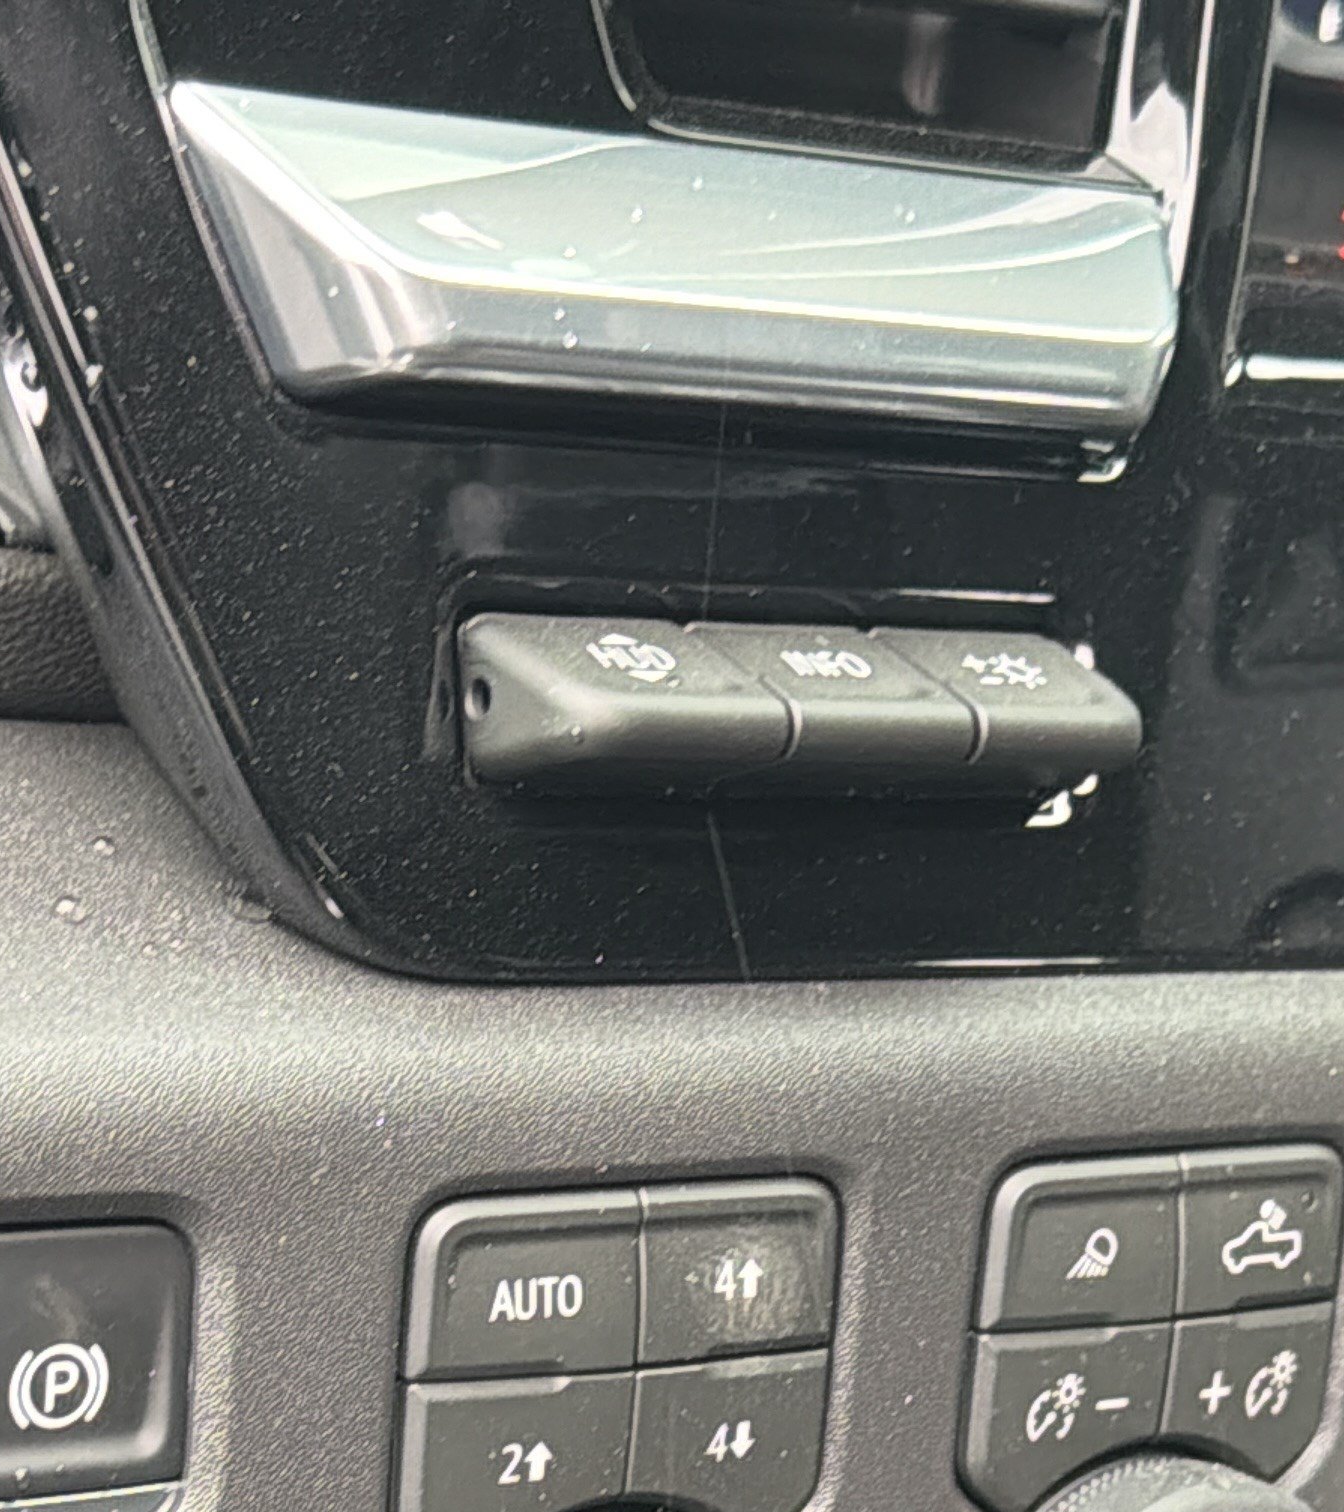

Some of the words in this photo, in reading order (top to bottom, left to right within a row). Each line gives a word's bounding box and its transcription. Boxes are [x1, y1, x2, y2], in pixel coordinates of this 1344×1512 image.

[586, 642, 676, 671] HUD
[488, 1274, 584, 1323] AUTO
[44, 1360, 80, 1413] P
